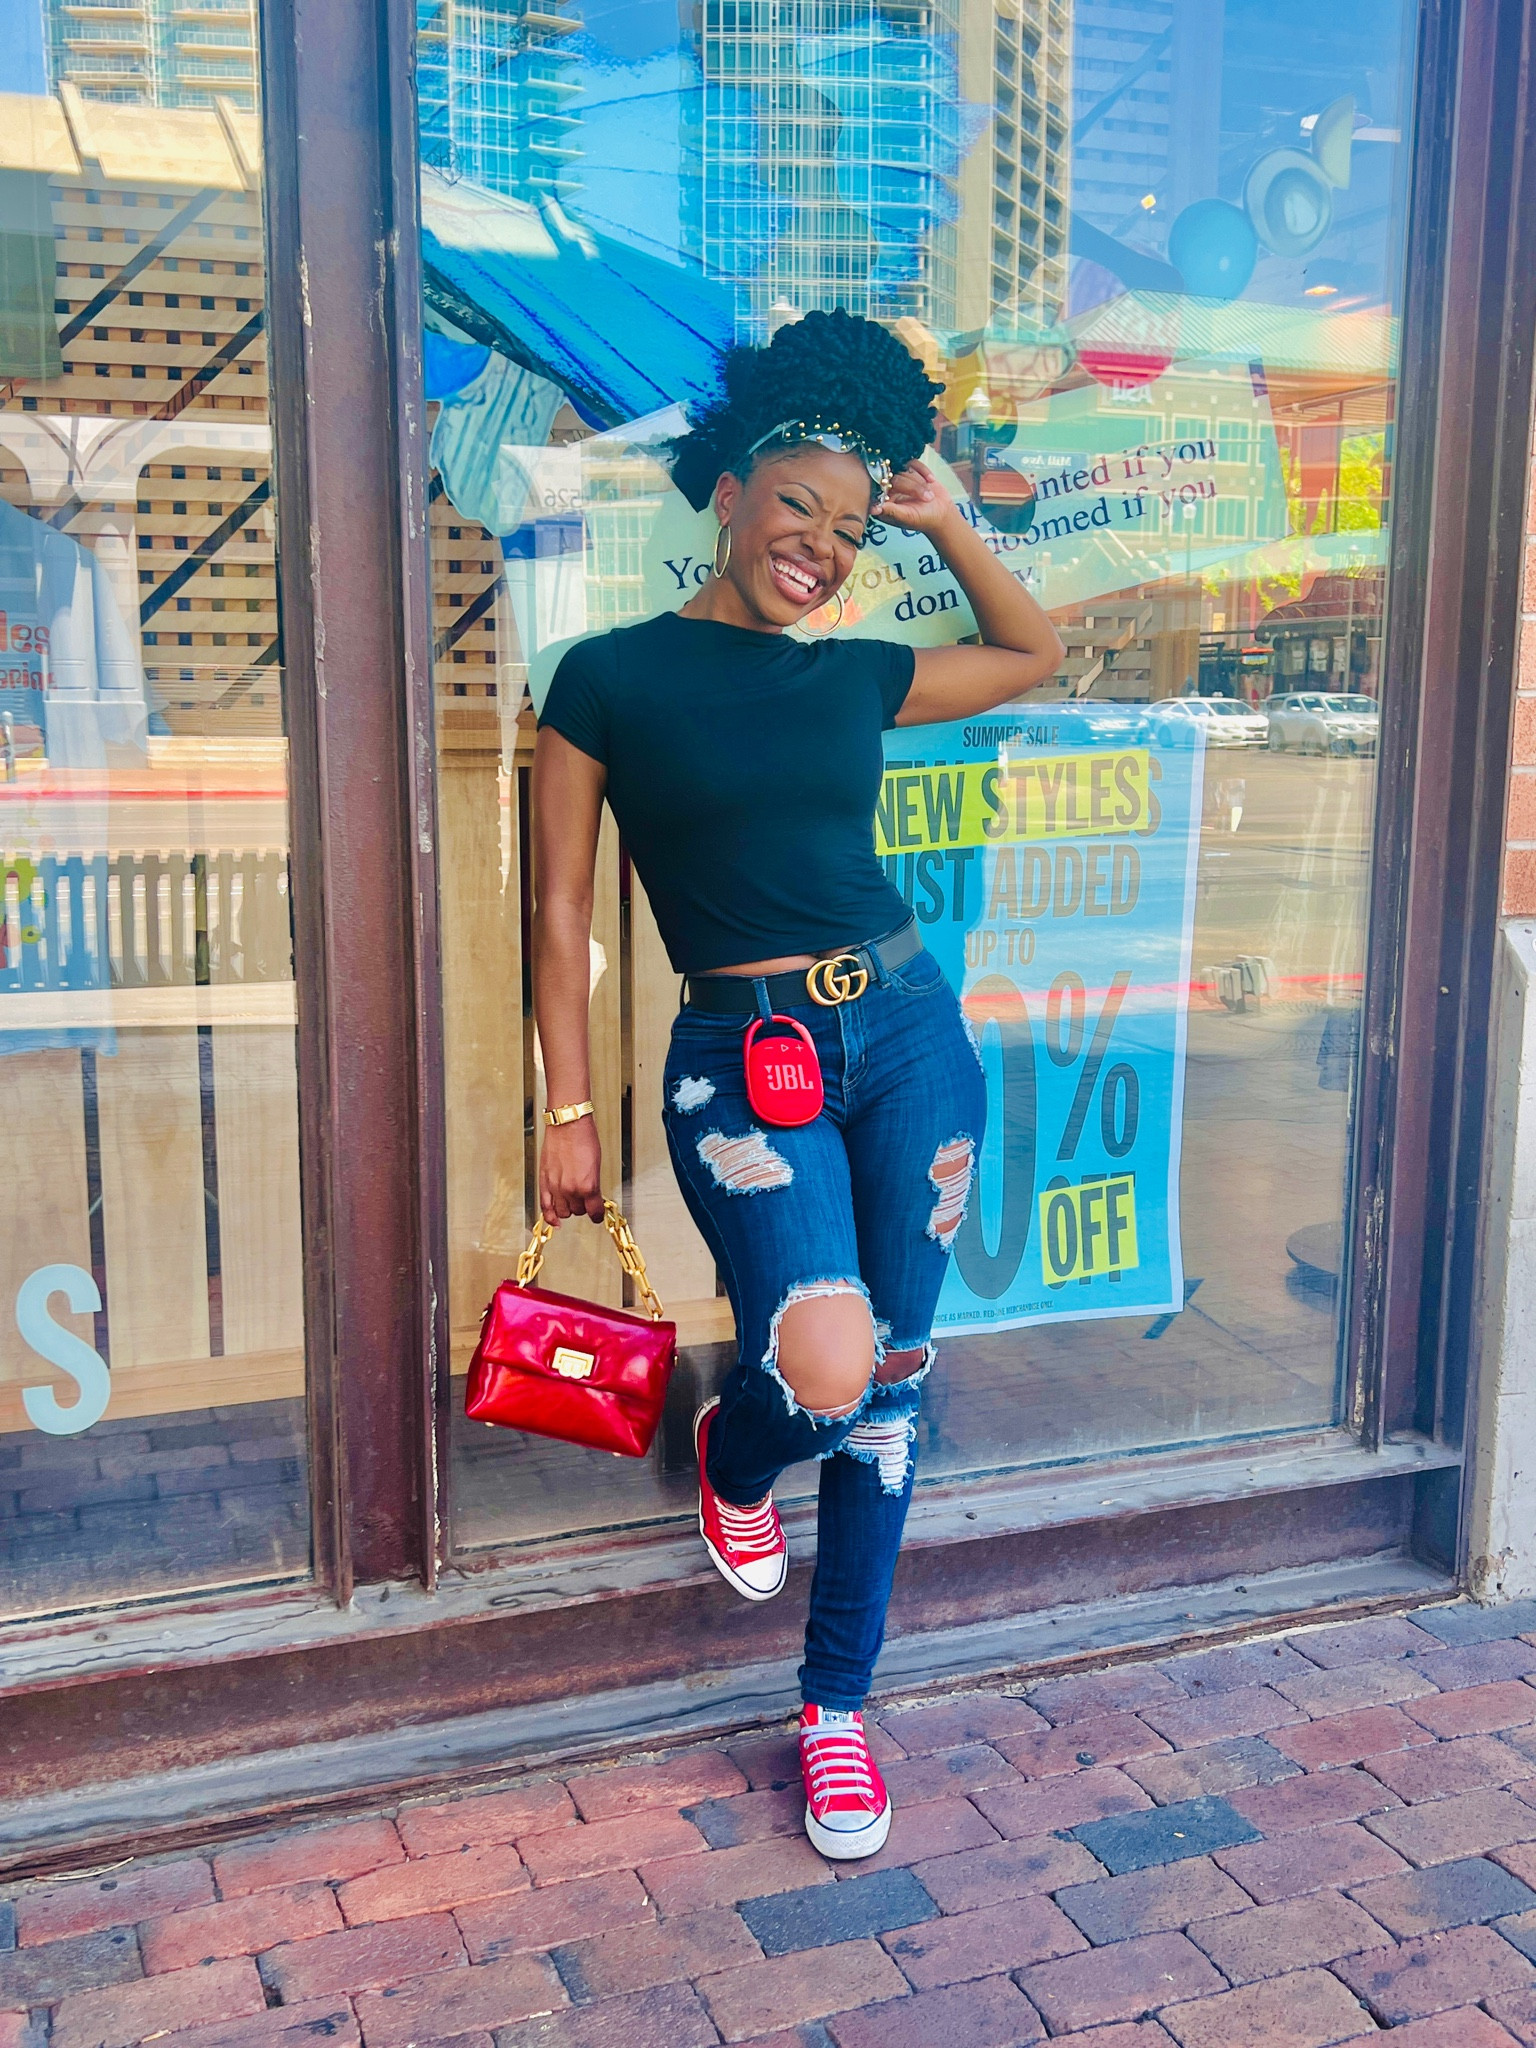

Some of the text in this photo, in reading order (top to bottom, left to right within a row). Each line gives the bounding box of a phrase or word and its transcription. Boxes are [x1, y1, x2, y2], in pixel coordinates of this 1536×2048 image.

[1122, 445, 1149, 479] if
[1156, 439, 1217, 478] you
[1122, 486, 1149, 520] if
[1158, 479, 1218, 519] you
[962, 725, 1060, 748] SUMMER SALE
[873, 755, 1142, 848] NEW STYLES
[876, 844, 1141, 924] UST ADDED
[965, 927, 1036, 969] UP TO
[764, 1063, 815, 1091] JBL
[1046, 1181, 1130, 1278] OFF
[15, 1263, 112, 1436] S
